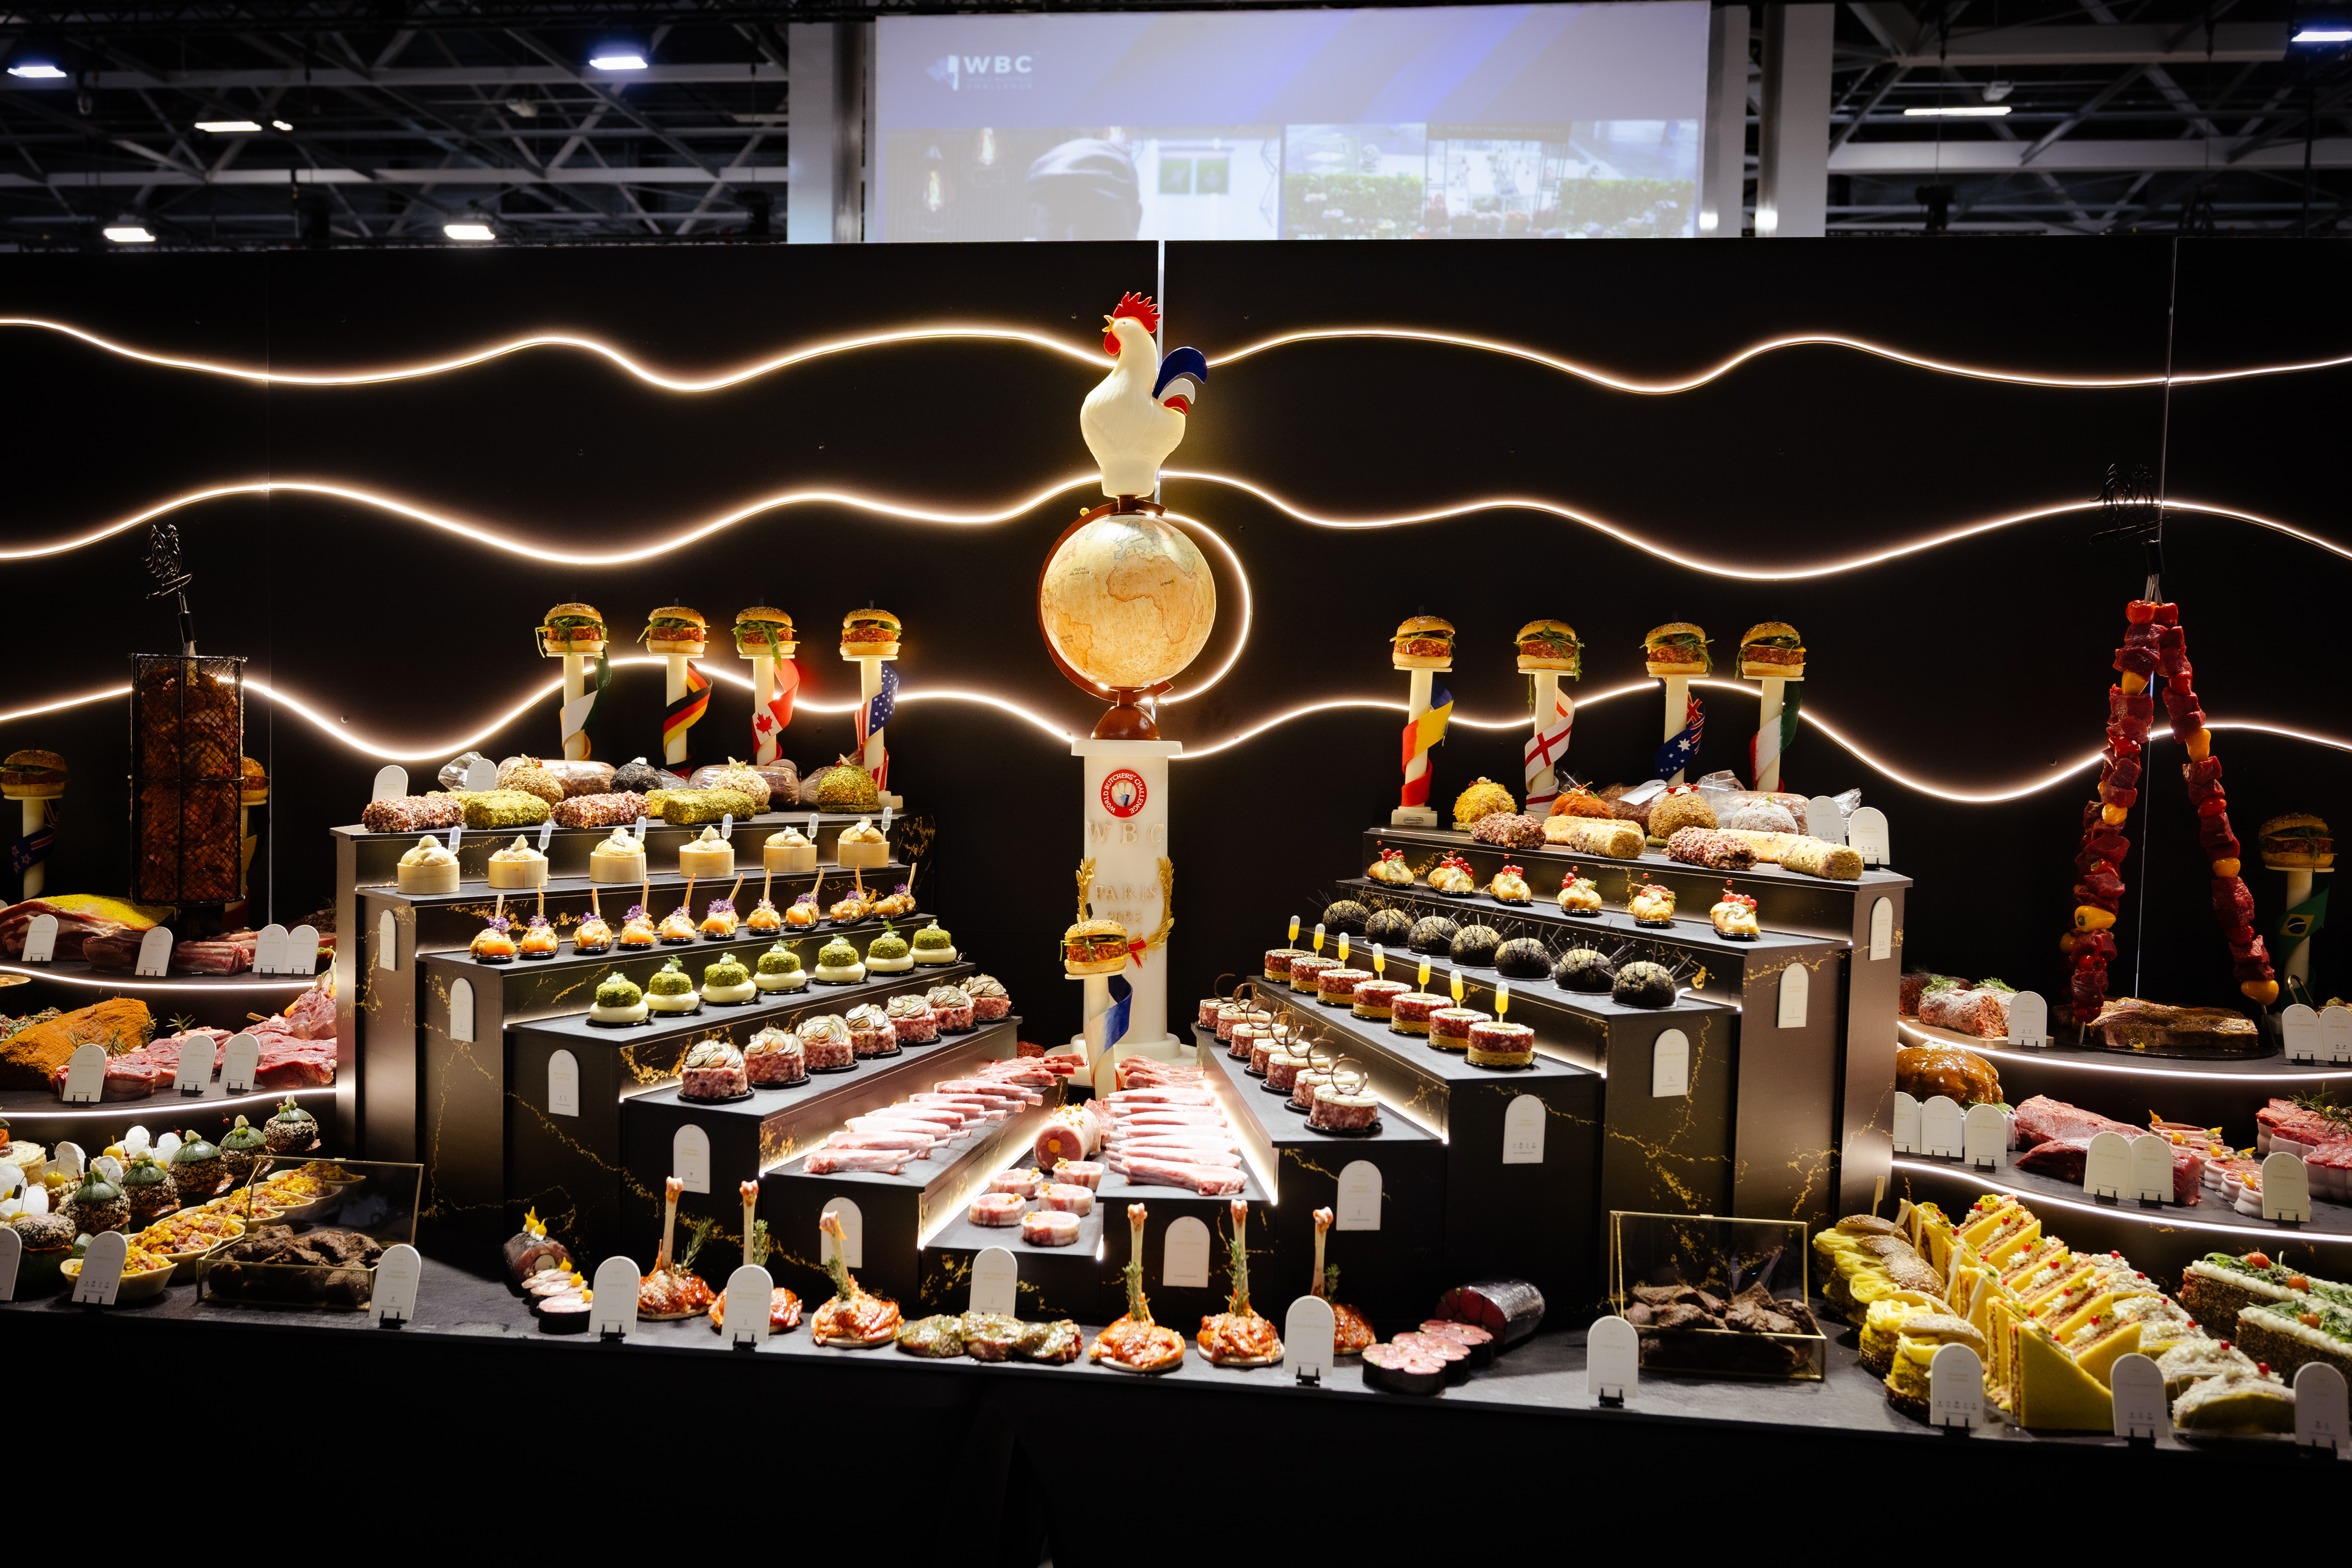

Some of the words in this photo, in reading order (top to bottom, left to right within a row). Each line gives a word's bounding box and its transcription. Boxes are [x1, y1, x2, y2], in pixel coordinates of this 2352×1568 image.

[963, 55, 1033, 73] WBC
[1104, 773, 1136, 790] BUTCHERS'
[1103, 790, 1116, 813] WORLD
[1129, 778, 1145, 814] CHALLENGE
[1086, 821, 1165, 844] WBC
[1093, 884, 1157, 901] PARIS
[1107, 911, 1143, 924] 2025
